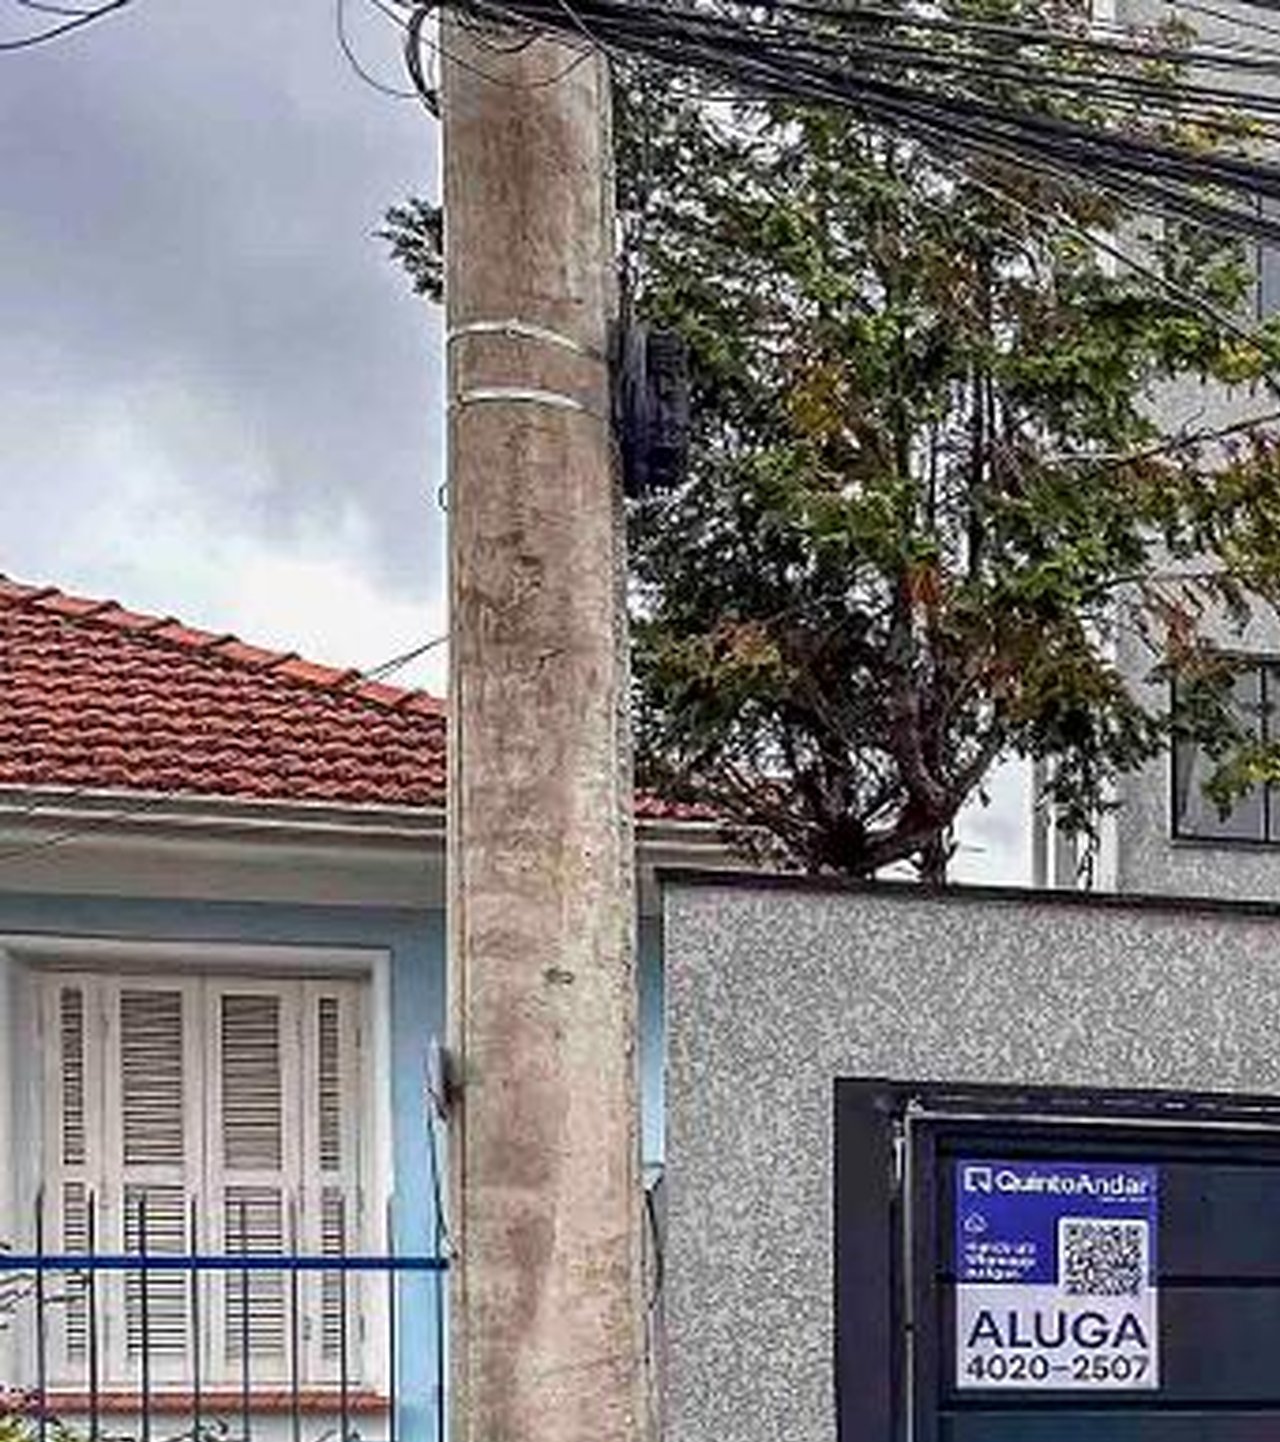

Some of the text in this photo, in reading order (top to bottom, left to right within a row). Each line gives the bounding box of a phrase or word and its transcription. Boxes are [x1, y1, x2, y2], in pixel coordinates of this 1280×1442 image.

[994, 1170, 1150, 1196] QuintoAndar
[967, 1310, 1148, 1349] ALUGA
[967, 1355, 1149, 1381] 4020-2507
